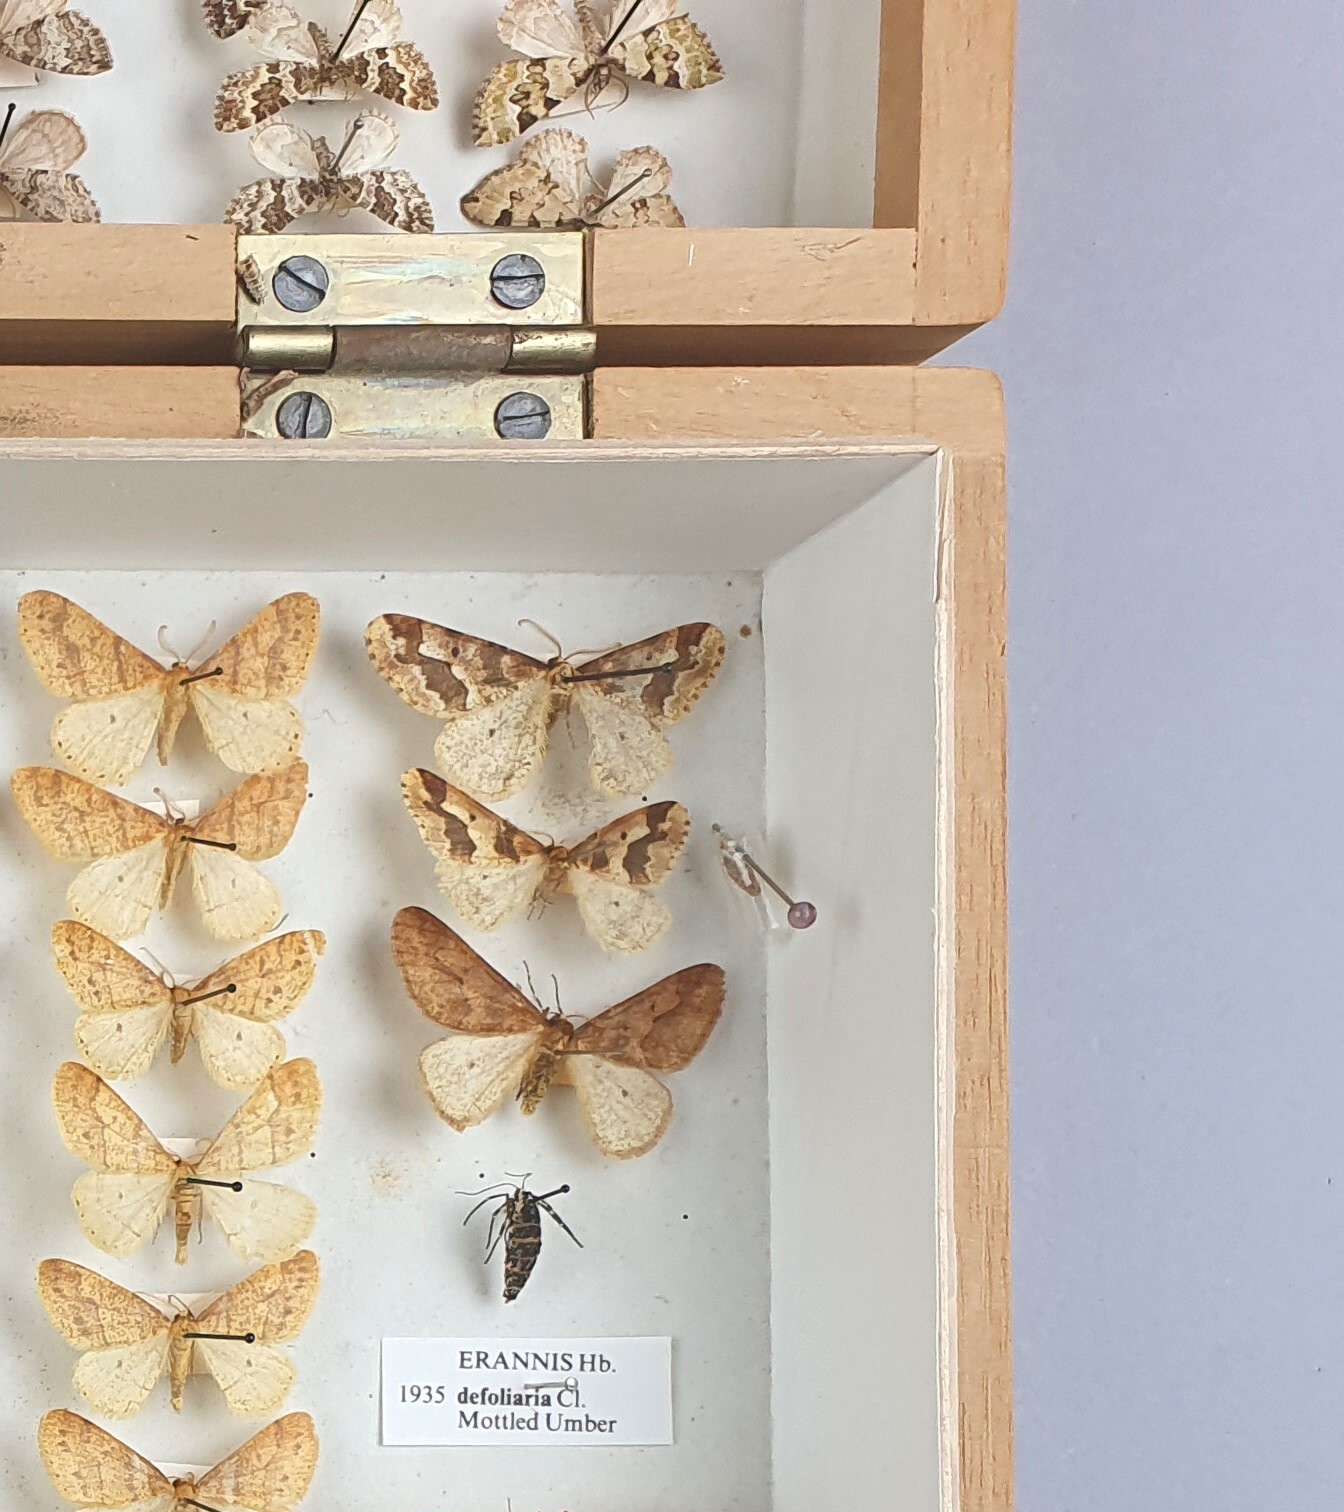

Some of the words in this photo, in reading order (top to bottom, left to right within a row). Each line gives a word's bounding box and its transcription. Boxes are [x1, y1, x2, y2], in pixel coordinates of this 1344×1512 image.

[458, 1351, 573, 1372] ERANNIS
[579, 1354, 617, 1373] Hb.
[400, 1384, 446, 1404] 1935
[457, 1387, 552, 1408] defoliaria
[556, 1387, 586, 1409] Cl.
[458, 1410, 539, 1431] Mottled
[545, 1413, 617, 1433] Umber
